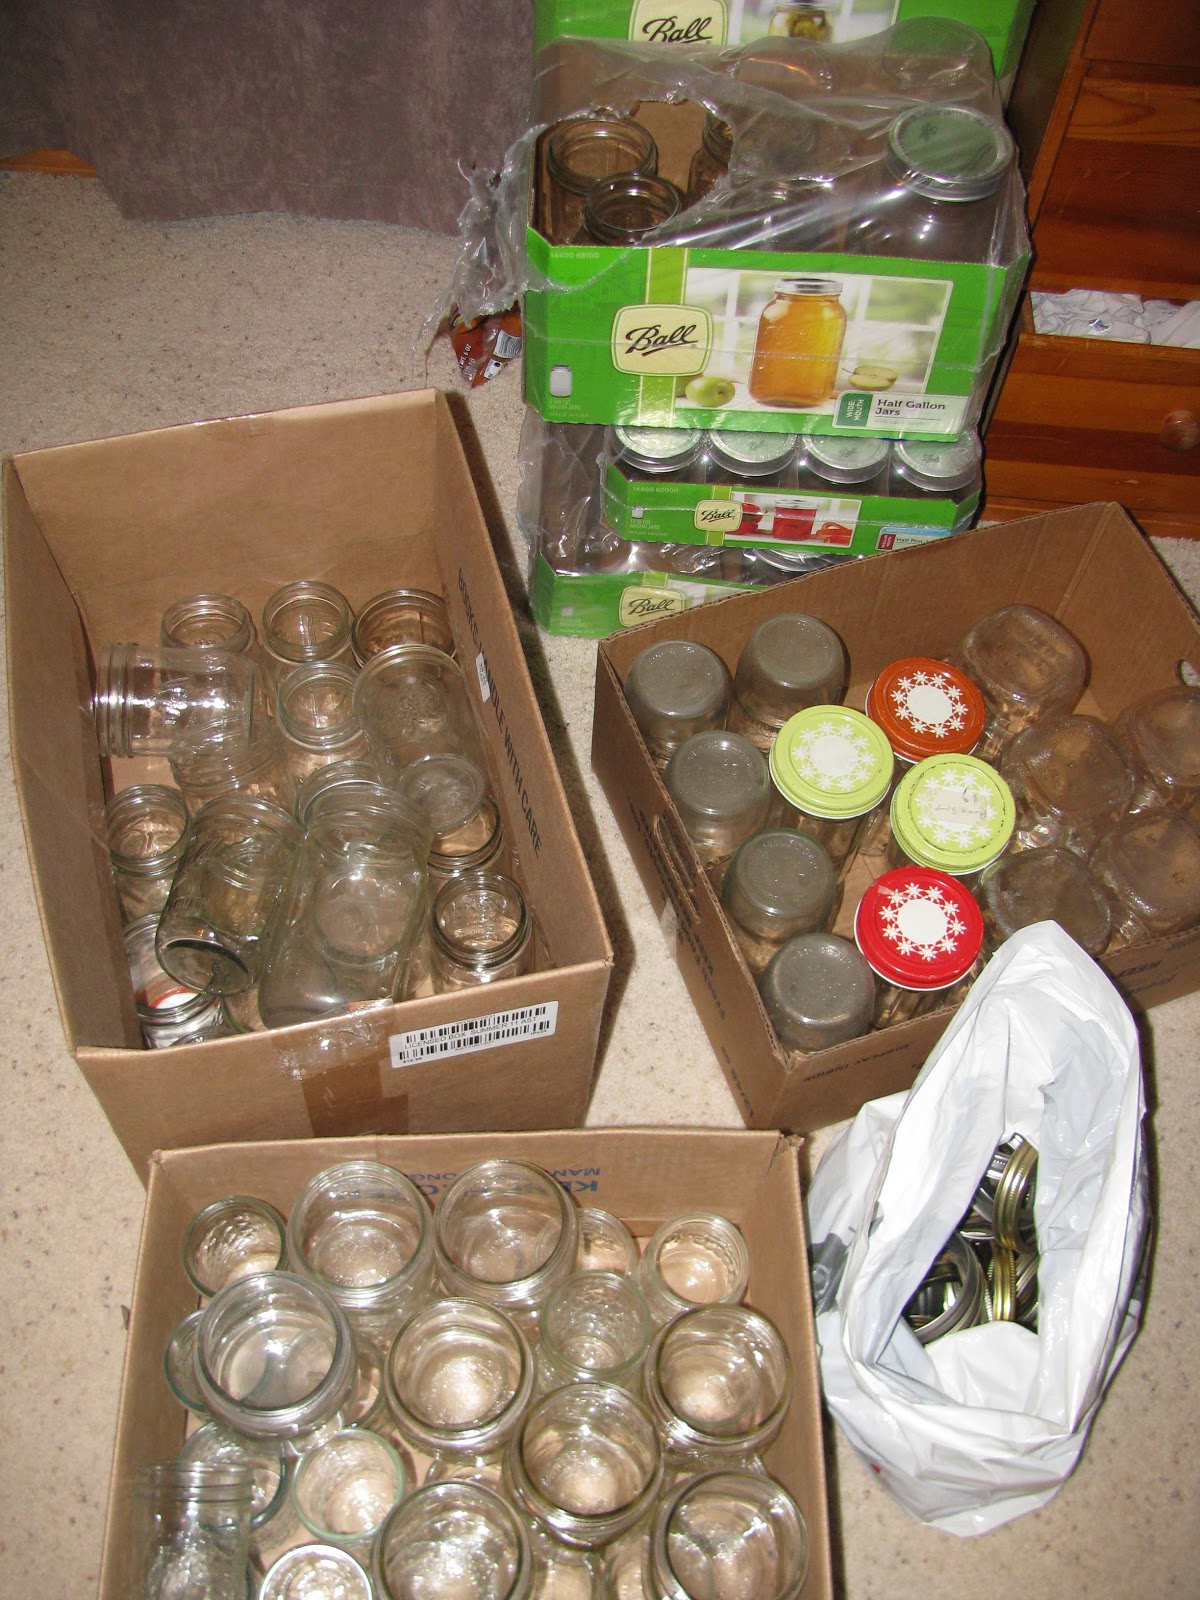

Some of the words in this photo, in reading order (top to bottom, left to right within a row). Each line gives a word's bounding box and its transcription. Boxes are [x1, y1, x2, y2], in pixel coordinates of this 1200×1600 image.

[642, 16, 713, 44] Ball
[625, 324, 698, 357] Ball
[846, 401, 855, 418] WIDE
[854, 399, 865, 421] MOUTH
[875, 407, 900, 416] Jars
[877, 399, 903, 409] Half
[905, 400, 946, 411] Gallon
[700, 509, 736, 523] Ball
[628, 598, 675, 617] Ball
[503, 727, 523, 796] WITH
[520, 795, 542, 860] CARE
[404, 1035, 447, 1050] LICENSED
[448, 1031, 467, 1041] BOX
[470, 1022, 508, 1036] SUMMER
[510, 1020, 519, 1028] 11
[520, 1016, 538, 1024] AST
